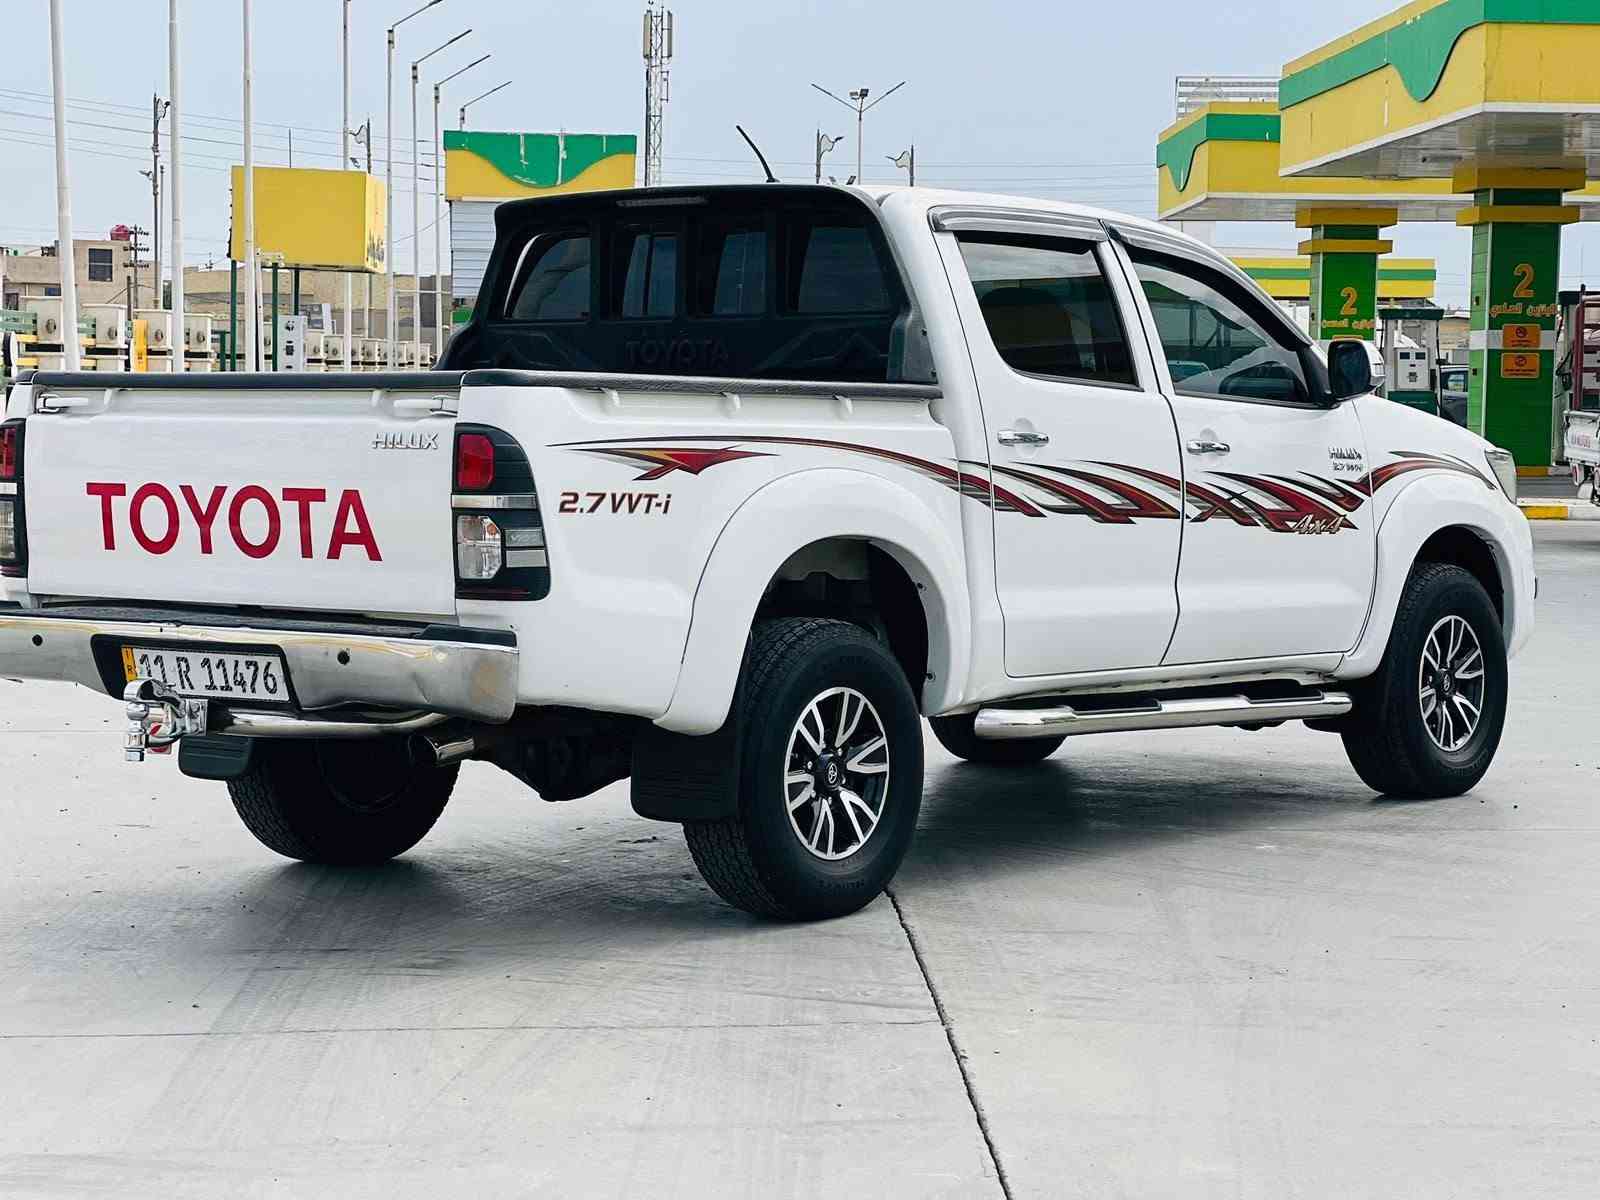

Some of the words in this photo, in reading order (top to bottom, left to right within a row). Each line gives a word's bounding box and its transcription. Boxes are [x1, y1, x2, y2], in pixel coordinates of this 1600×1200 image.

[1513, 264, 1535, 298] 2
[1340, 287, 1357, 315] 2
[625, 338, 729, 368] TOYOTA
[372, 433, 438, 449] HILUX
[559, 492, 607, 513] 2.7
[610, 493, 671, 514] VVT-i
[86, 482, 383, 562] TOYOTA
[1293, 514, 1342, 535] 4x4
[139, 653, 168, 684] 11
[176, 656, 194, 690] R
[201, 657, 278, 694] 11476
